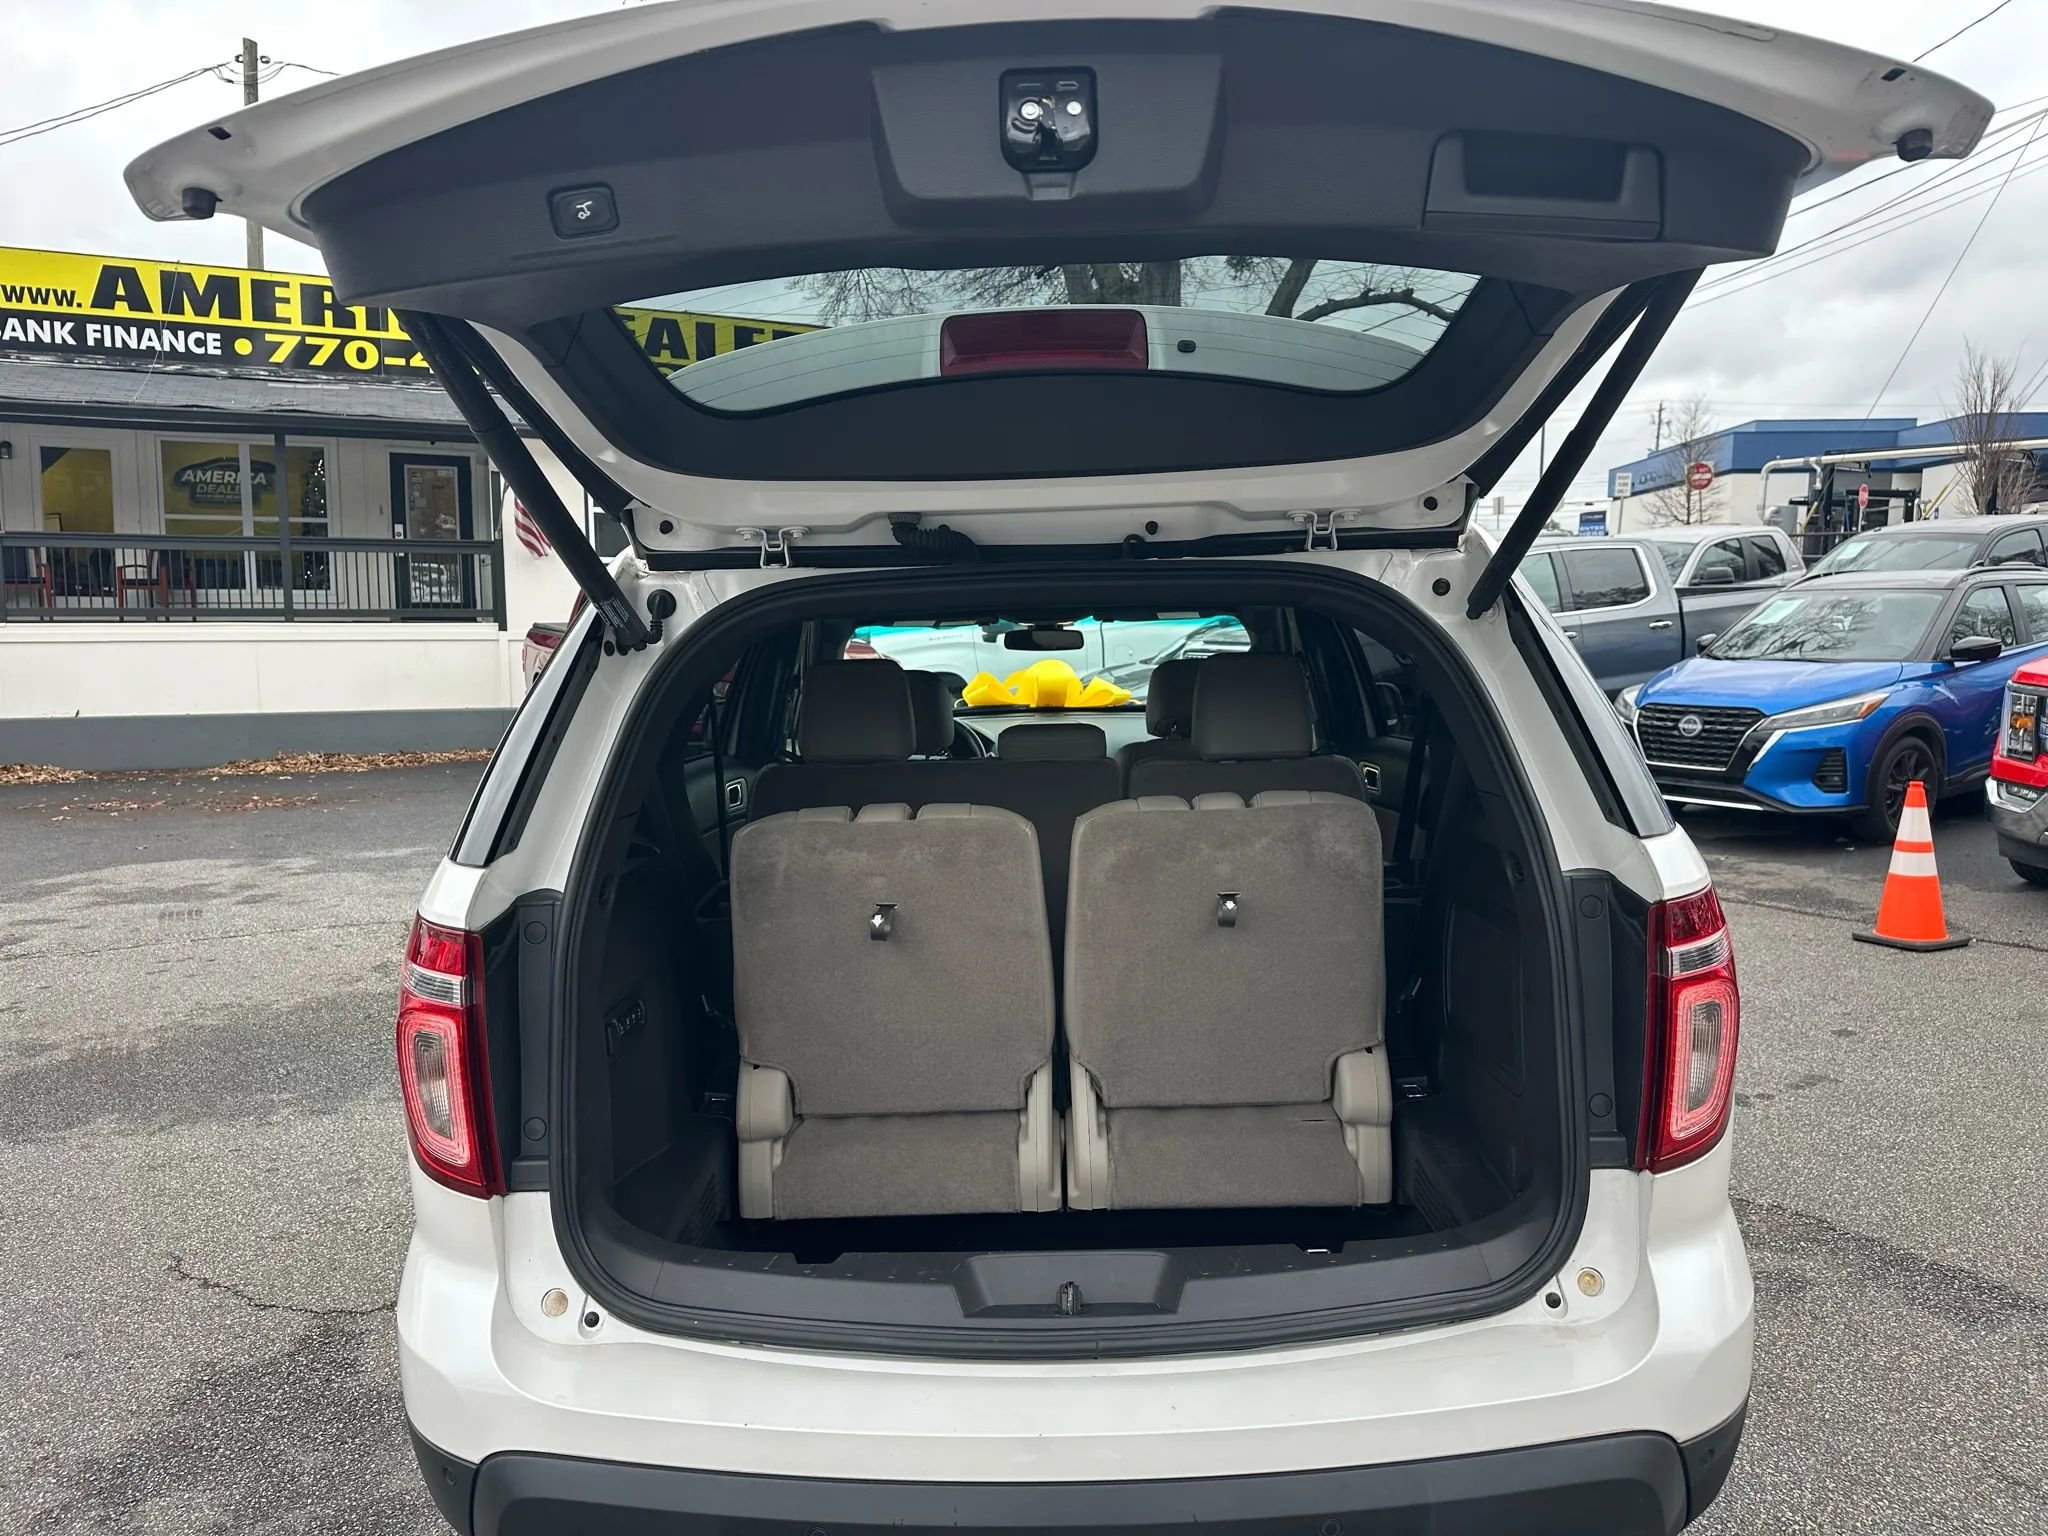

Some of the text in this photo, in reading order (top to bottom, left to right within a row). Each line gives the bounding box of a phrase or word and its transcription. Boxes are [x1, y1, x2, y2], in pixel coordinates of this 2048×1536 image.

[0, 317, 77, 346] ANK
[86, 323, 222, 355] FINANCE
[181, 469, 267, 485] AMERIA
[196, 483, 241, 495] DEALE
